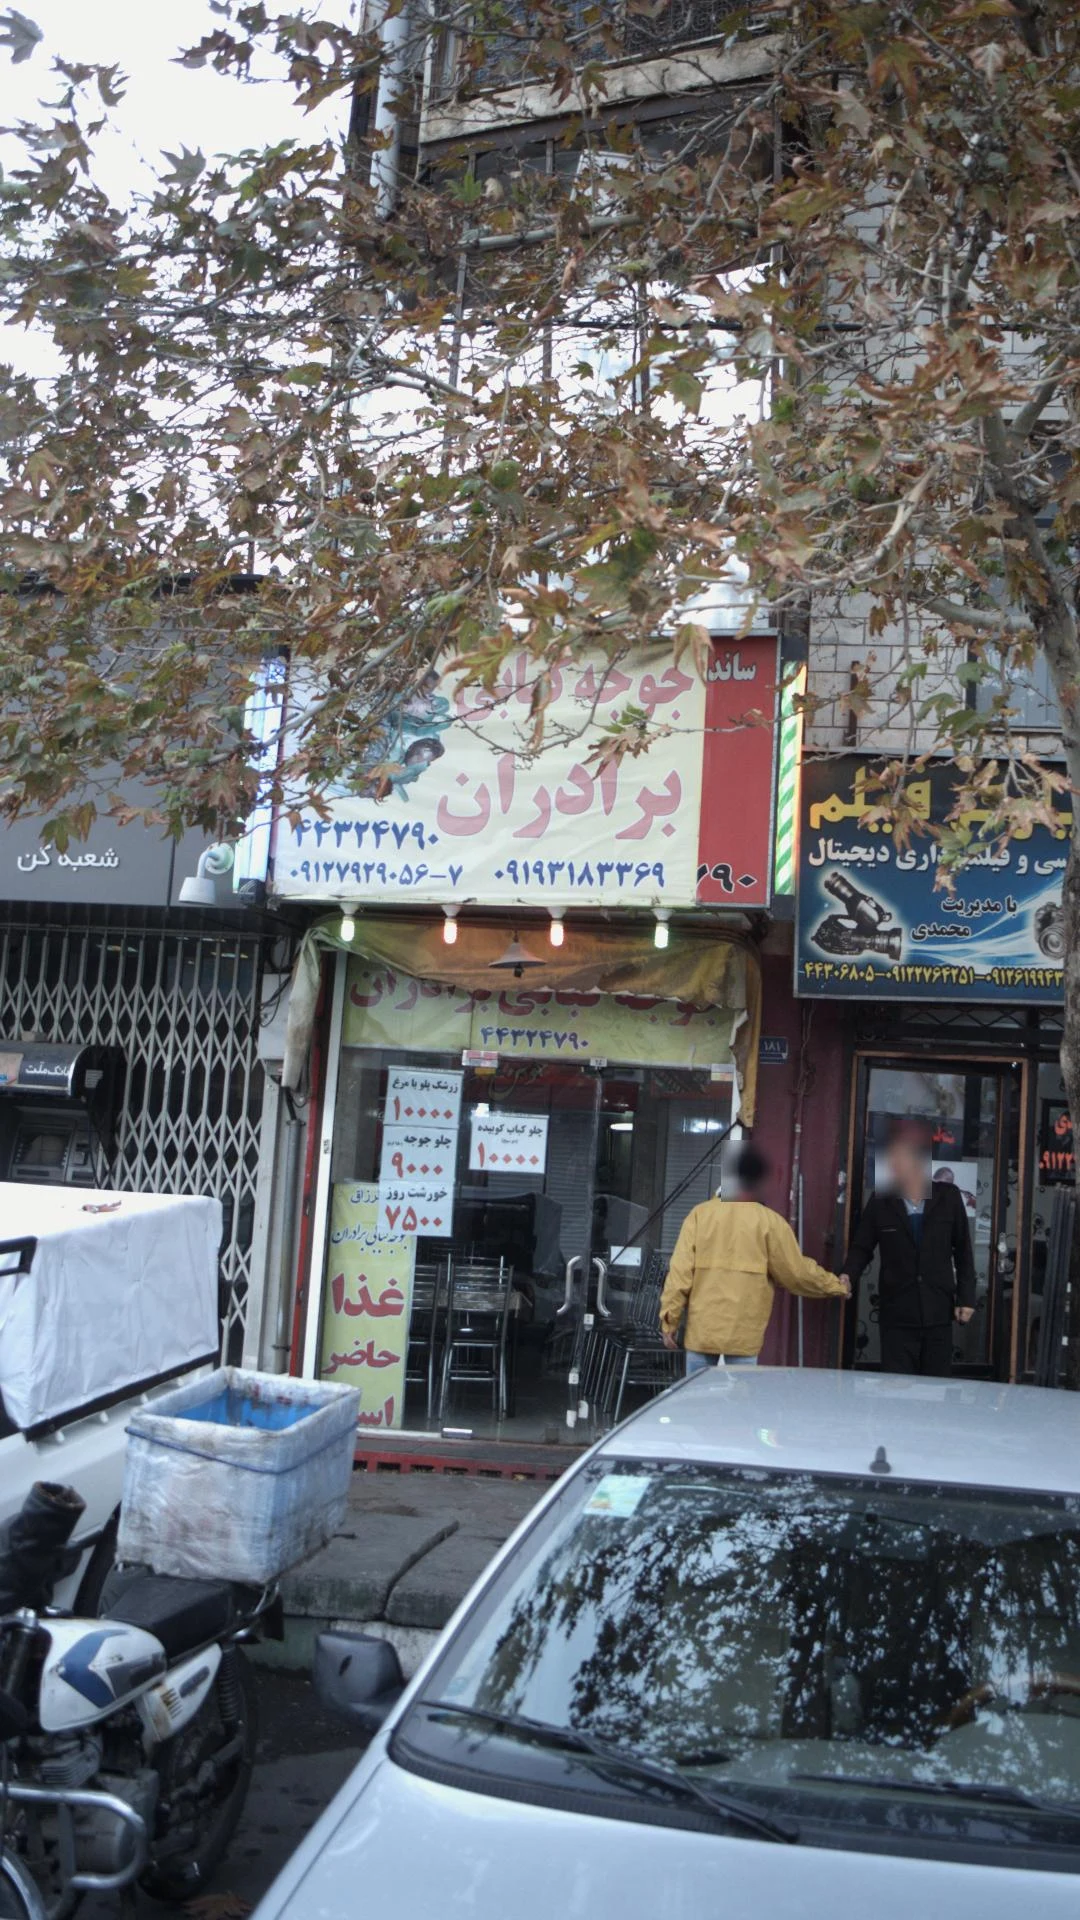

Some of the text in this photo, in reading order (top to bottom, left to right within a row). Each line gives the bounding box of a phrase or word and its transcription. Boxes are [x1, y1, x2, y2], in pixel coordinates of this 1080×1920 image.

[457, 651, 696, 721] جوجه کابی
[436, 750, 682, 841] برادران
[295, 819, 439, 850] ۴۴۳۲۴۷۹۰
[17, 844, 120, 872] شعبه کن
[808, 837, 891, 870] دیجیتال
[895, 843, 1010, 872] فیلمباری
[1016, 854, 1029, 874] و
[494, 859, 666, 888] ۰۹۱۹۳۱۸۳۳۶۹
[942, 896, 1017, 918] با مدیریت
[911, 921, 970, 942] محمدی
[480, 1026, 589, 1049] ۴۴۳۲۴۷۹۰
[763, 1040, 781, 1052] ۱۸۱
[392, 1078, 458, 1094] زرشک پلو با مرغ
[393, 1095, 453, 1121] ۱۰۰۰۰
[403, 1136, 432, 1148] جوجه
[434, 1134, 452, 1149] چلو
[477, 1124, 504, 1135] کوبیده
[506, 1125, 526, 1135] کباب
[391, 1151, 443, 1178] ۹۰۰۰
[477, 1142, 539, 1168] ۱۰۰۰۰
[350, 1188, 379, 1204] رزاق
[386, 1186, 448, 1202] خورشت روز
[385, 1205, 443, 1231] ۷۵۰۰
[331, 1272, 405, 1318] غذا
[321, 1340, 401, 1374] حاضر
[358, 1396, 395, 1427] اس
